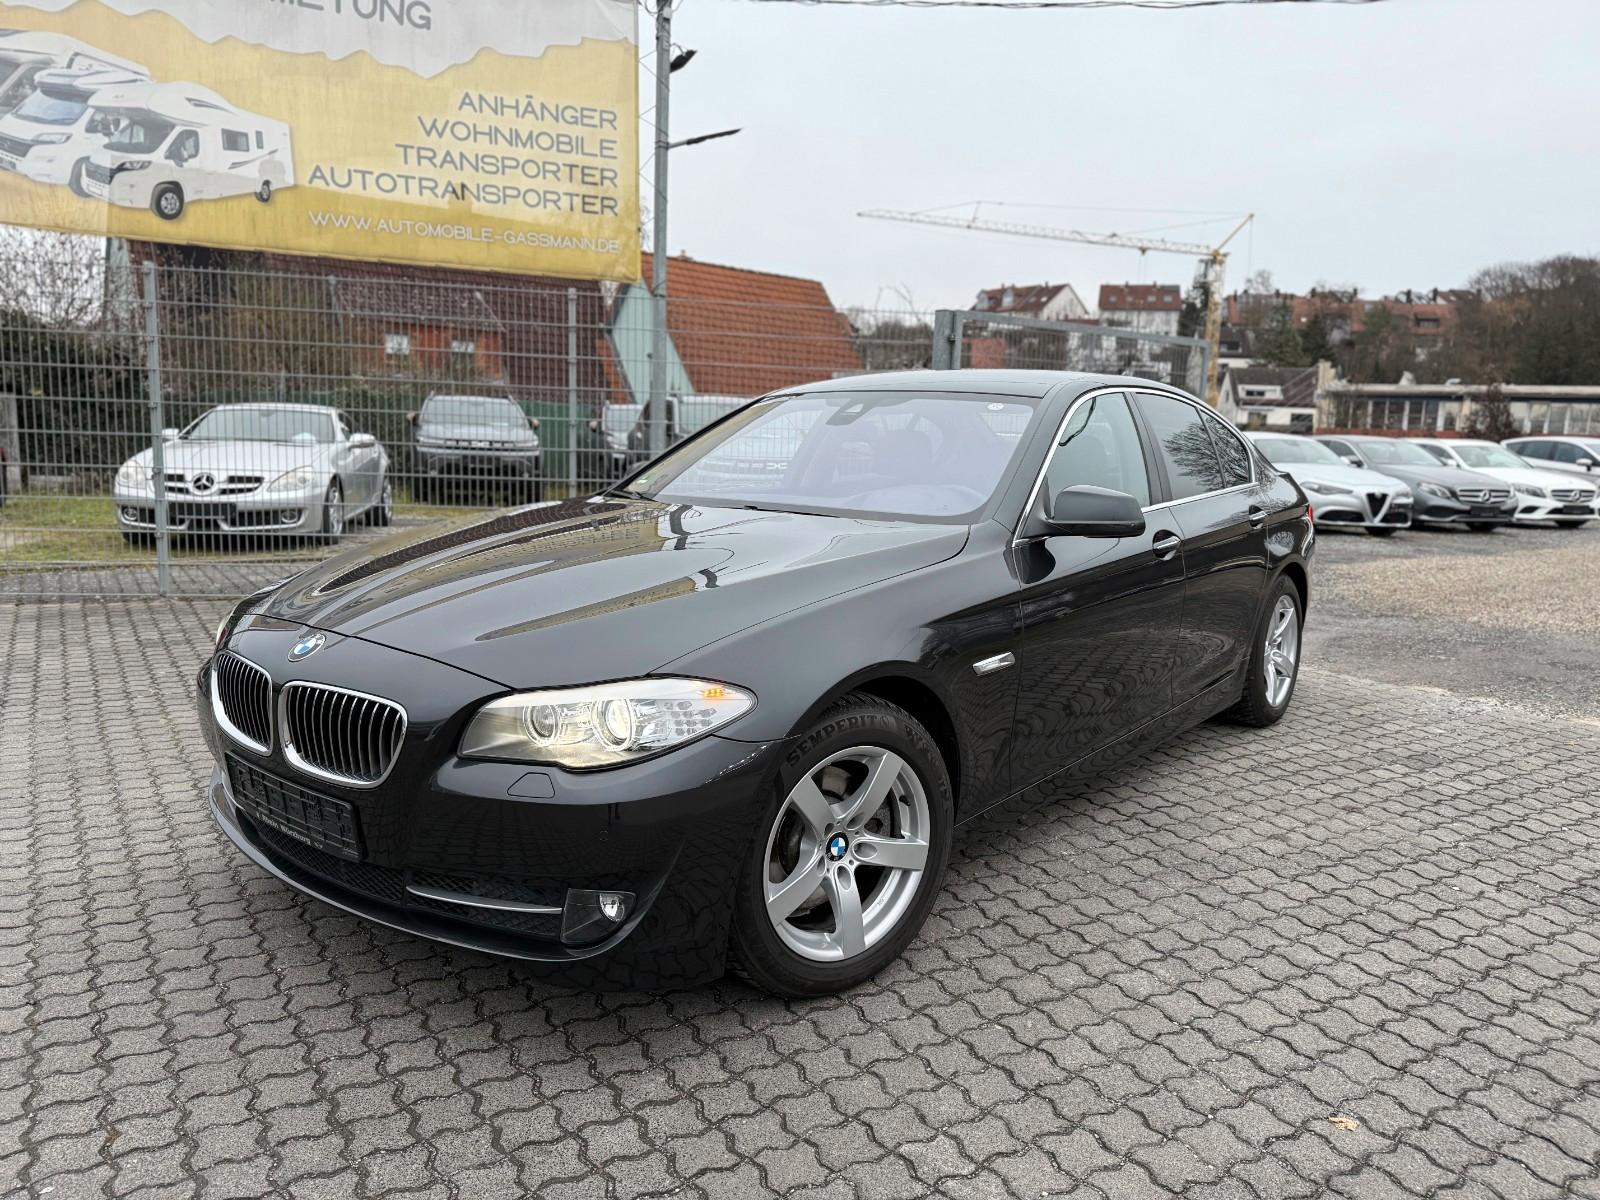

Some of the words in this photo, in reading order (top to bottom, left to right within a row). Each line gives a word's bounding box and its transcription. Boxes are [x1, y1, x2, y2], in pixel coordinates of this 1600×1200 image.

[457, 91, 618, 131] ANHÄNGER
[417, 115, 618, 159] WOHNMOBILE
[395, 143, 618, 188] TRANSPORTER
[308, 164, 619, 216] AUTOTRANSPORTER
[308, 210, 621, 254] WWW.AUTOMOBILE-GASSMANN.DE
[786, 714, 879, 767] SEMPERIT
